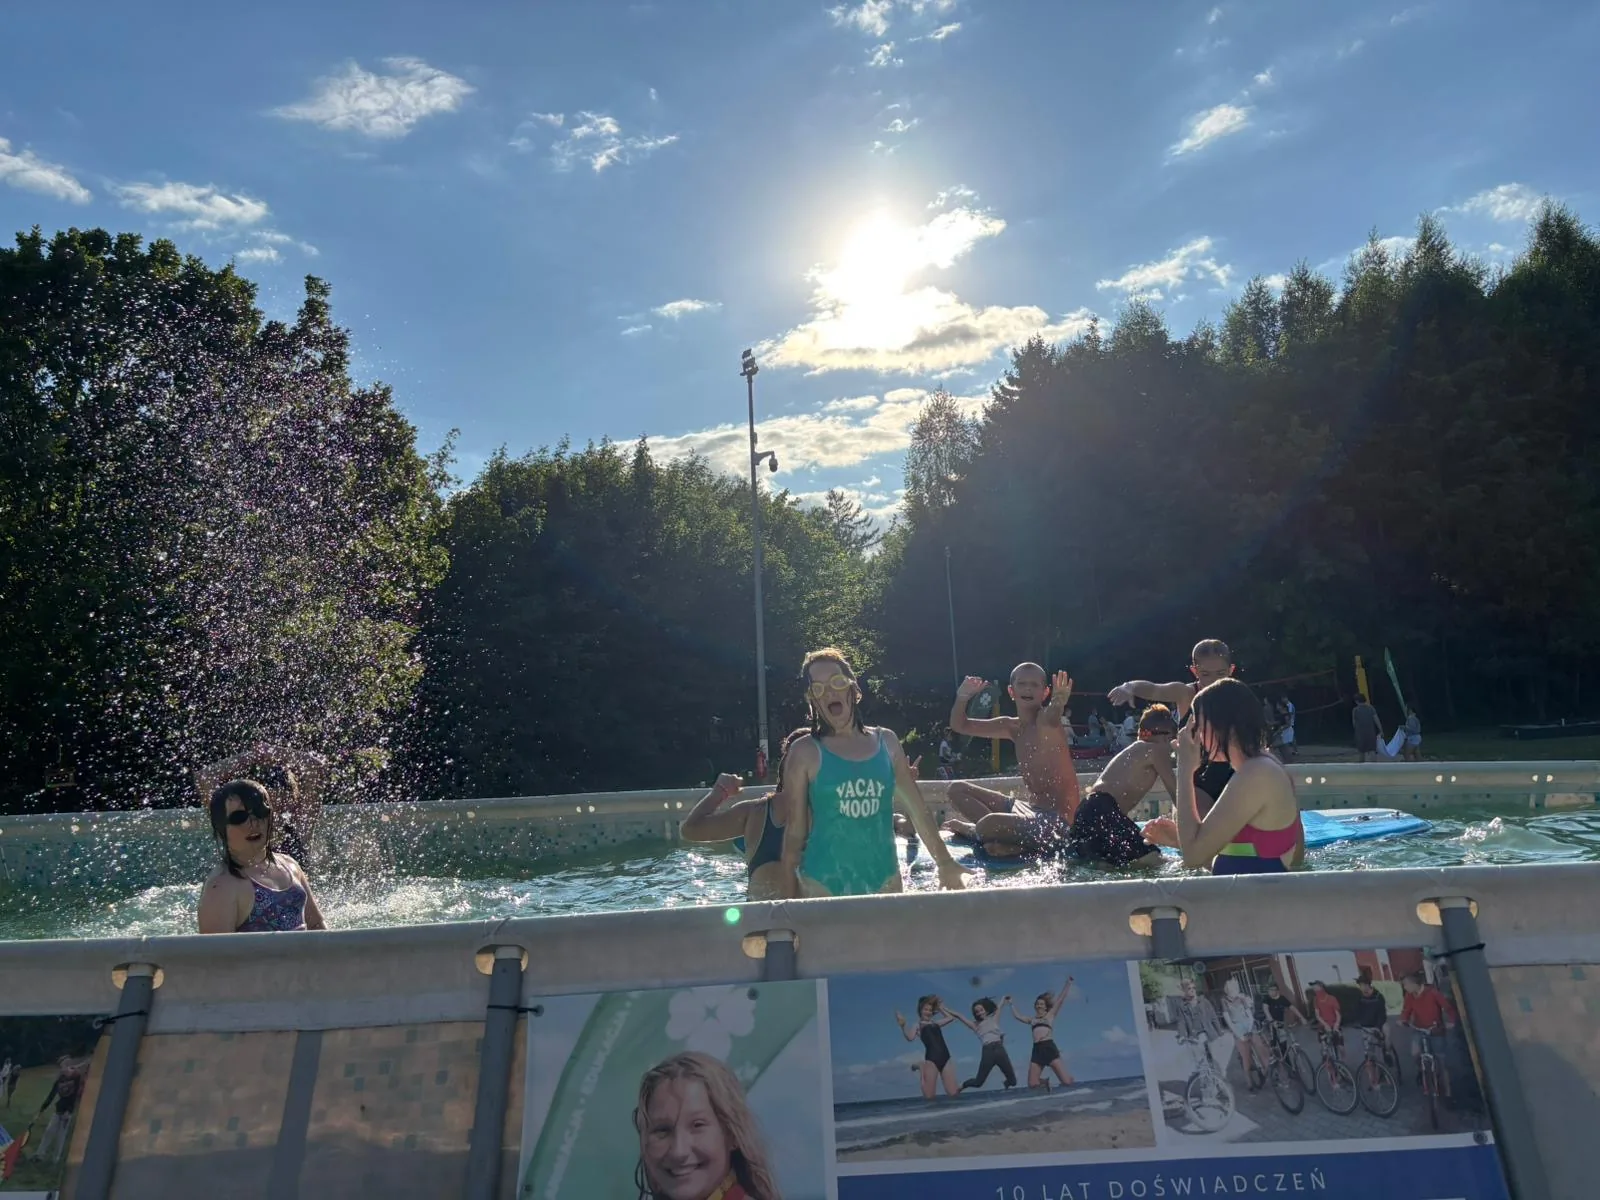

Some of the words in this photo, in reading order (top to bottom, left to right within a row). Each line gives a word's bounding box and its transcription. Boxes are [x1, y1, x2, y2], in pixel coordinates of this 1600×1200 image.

[836, 778, 885, 798] VACAY
[839, 798, 880, 818] MOOD
[996, 1185, 1025, 1200] 10
[1042, 1182, 1090, 1200] LAT
[1109, 1168, 1326, 1199] DOŚWIADCZEŃ
